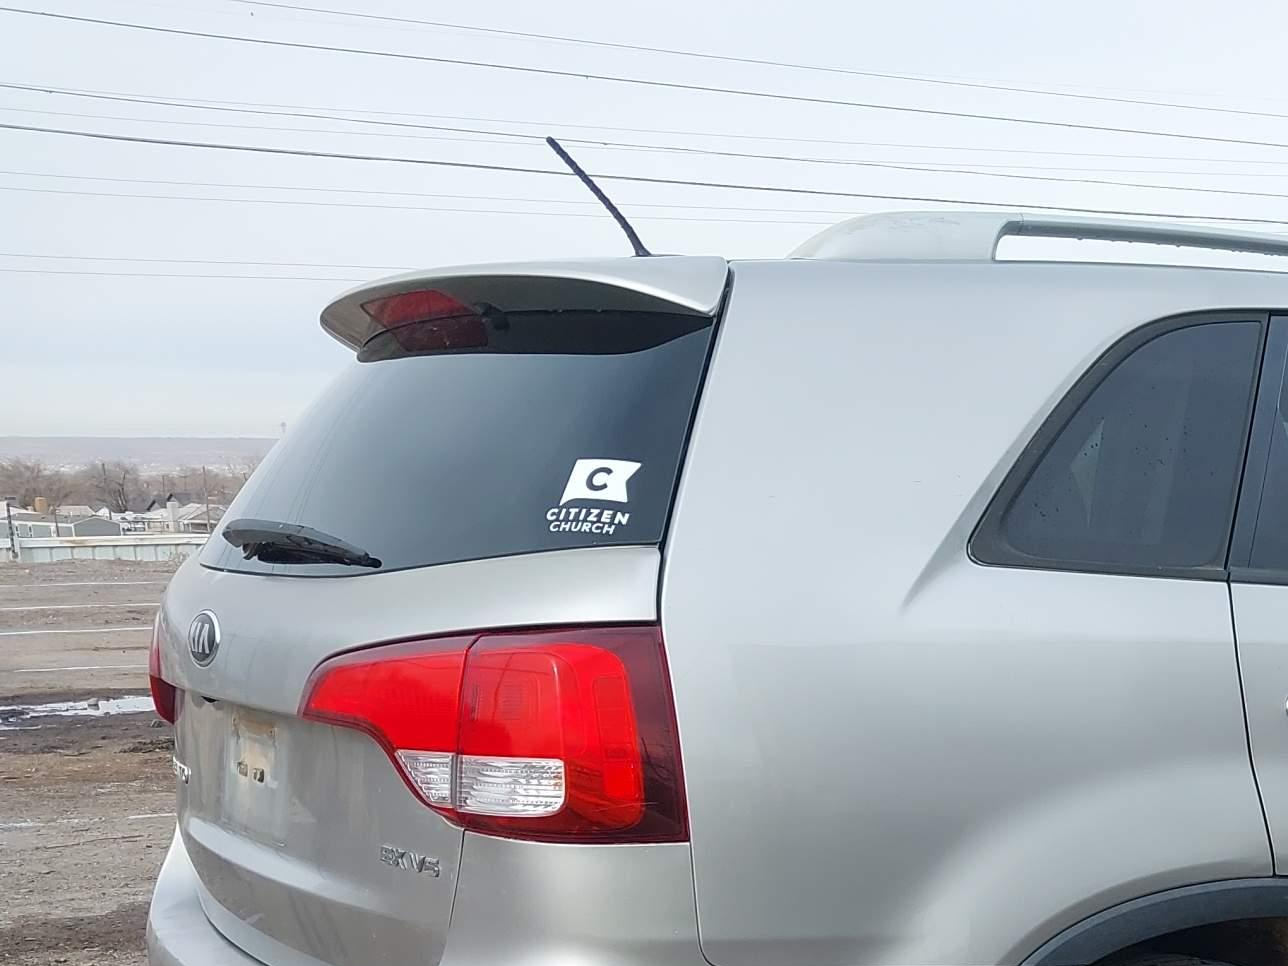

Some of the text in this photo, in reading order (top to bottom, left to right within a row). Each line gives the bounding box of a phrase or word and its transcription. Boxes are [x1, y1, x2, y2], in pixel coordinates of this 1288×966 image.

[585, 466, 614, 492] C
[546, 507, 630, 525] CITIZEN
[549, 521, 616, 535] CHURCH
